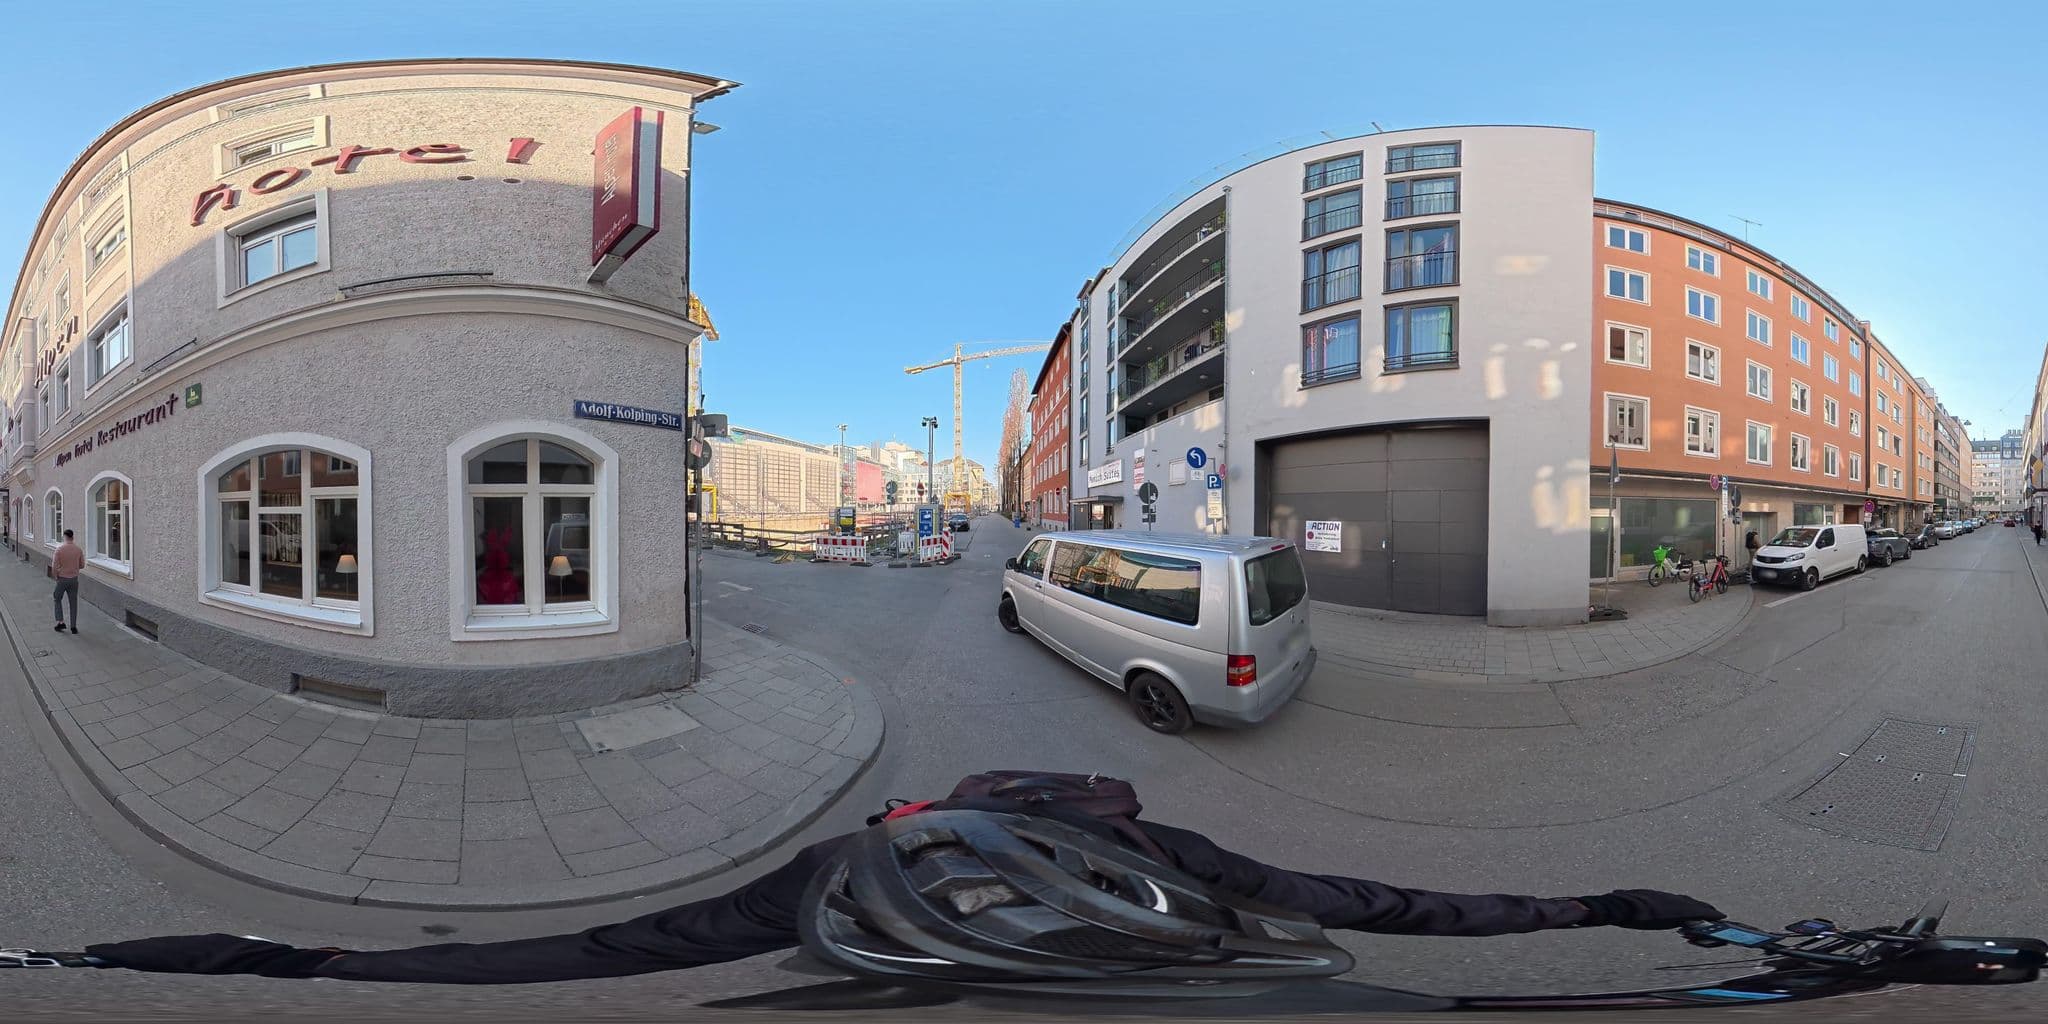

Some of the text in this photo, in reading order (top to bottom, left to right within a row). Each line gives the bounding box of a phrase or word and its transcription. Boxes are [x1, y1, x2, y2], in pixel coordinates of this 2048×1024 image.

[97, 393, 179, 447] Restaurant
[580, 402, 680, 427] Adolf-Kolping-Str.
[1209, 476, 1218, 488] P
[1311, 521, 1341, 532] ACTION
